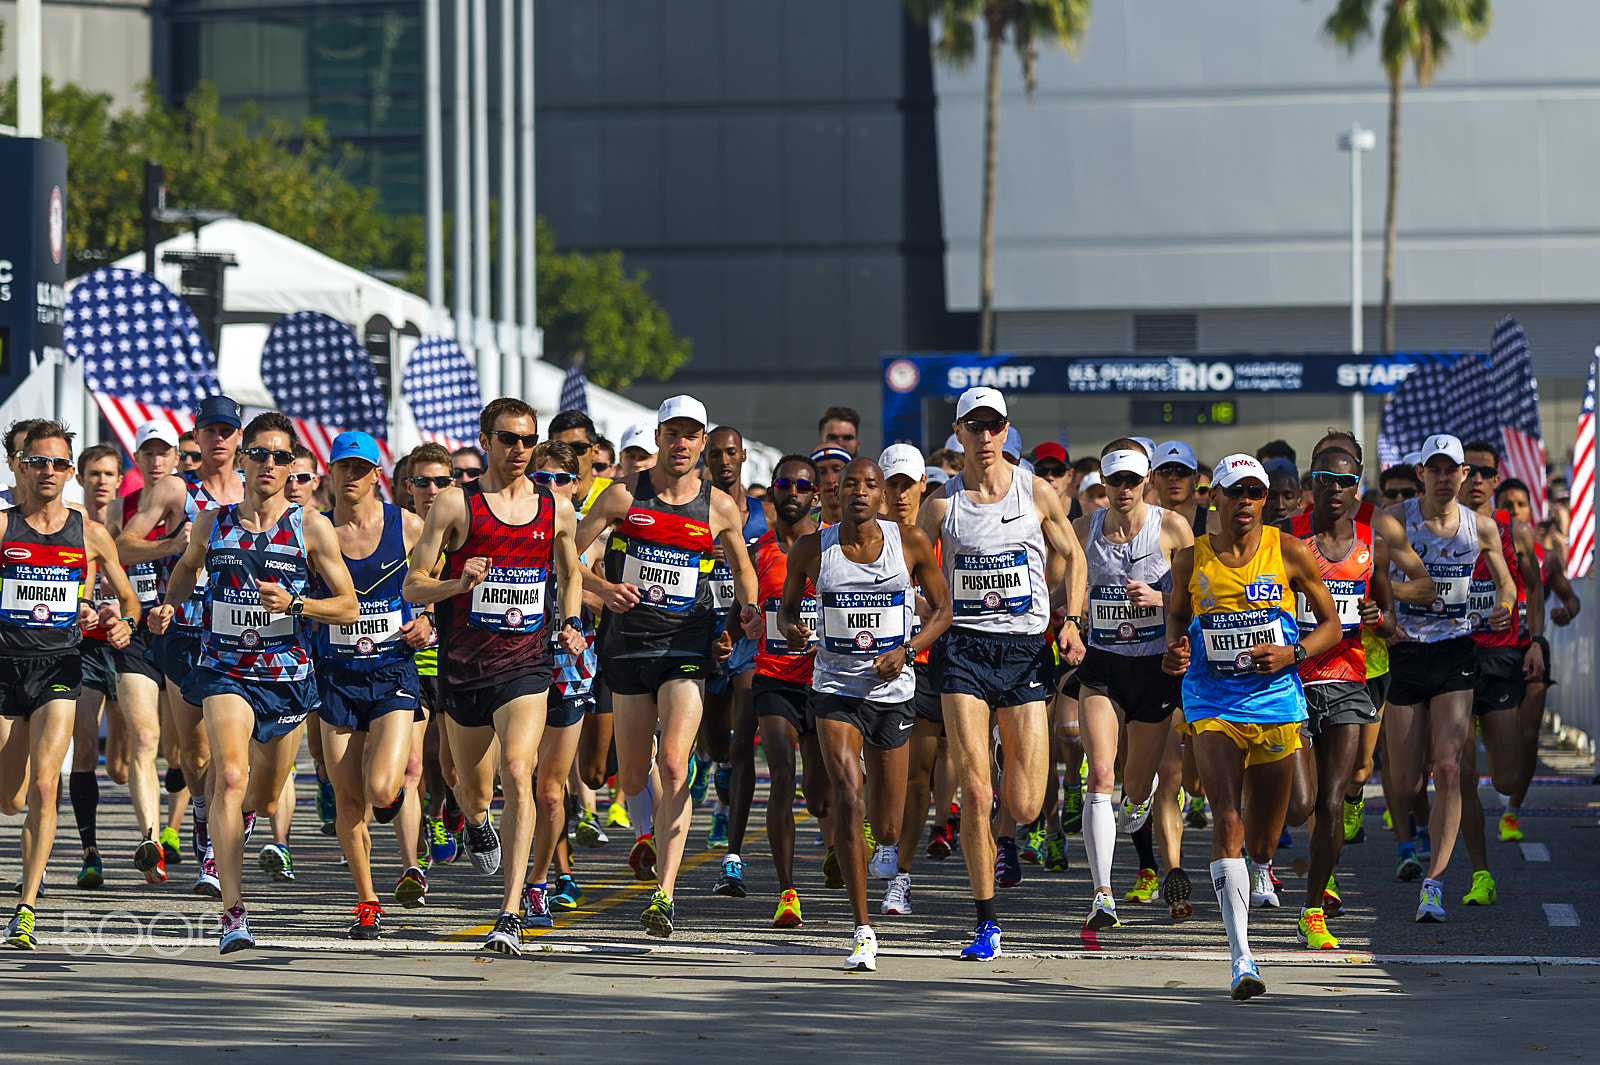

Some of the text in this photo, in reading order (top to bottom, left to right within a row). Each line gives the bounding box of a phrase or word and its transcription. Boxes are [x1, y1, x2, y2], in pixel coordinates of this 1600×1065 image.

[947, 366, 1034, 388] START
[1099, 364, 1169, 380] OLYMPIC
[1176, 362, 1234, 391] RIO
[1231, 460, 1256, 468] NYAC
[636, 553, 689, 567] TEAM TRIALS
[637, 546, 690, 561] U.S. OLYMPIC
[964, 553, 1015, 564] U.S. OLYMPIC
[16, 566, 70, 576] U.S. OLYMPIC
[988, 561, 1015, 569] TRIALS
[488, 568, 540, 577] U.S. OLYMPIC
[639, 565, 681, 586] CURTIS
[961, 572, 1022, 590] PUSKEDRA
[16, 585, 67, 602] MORGAN
[223, 588, 238, 597] U.S.
[480, 587, 539, 605] ARCINIAGA
[853, 593, 892, 601] OLYMPIC
[1245, 585, 1281, 600] USA
[358, 600, 389, 609] LYMPIC
[361, 606, 389, 614] TRIALS
[231, 609, 271, 627] LLANO
[847, 612, 882, 629] KIBET
[1212, 609, 1268, 623] U.S. OLYMPIC
[1238, 617, 1269, 627] TRIALS
[1210, 627, 1277, 651] KEFLEZIGHI
